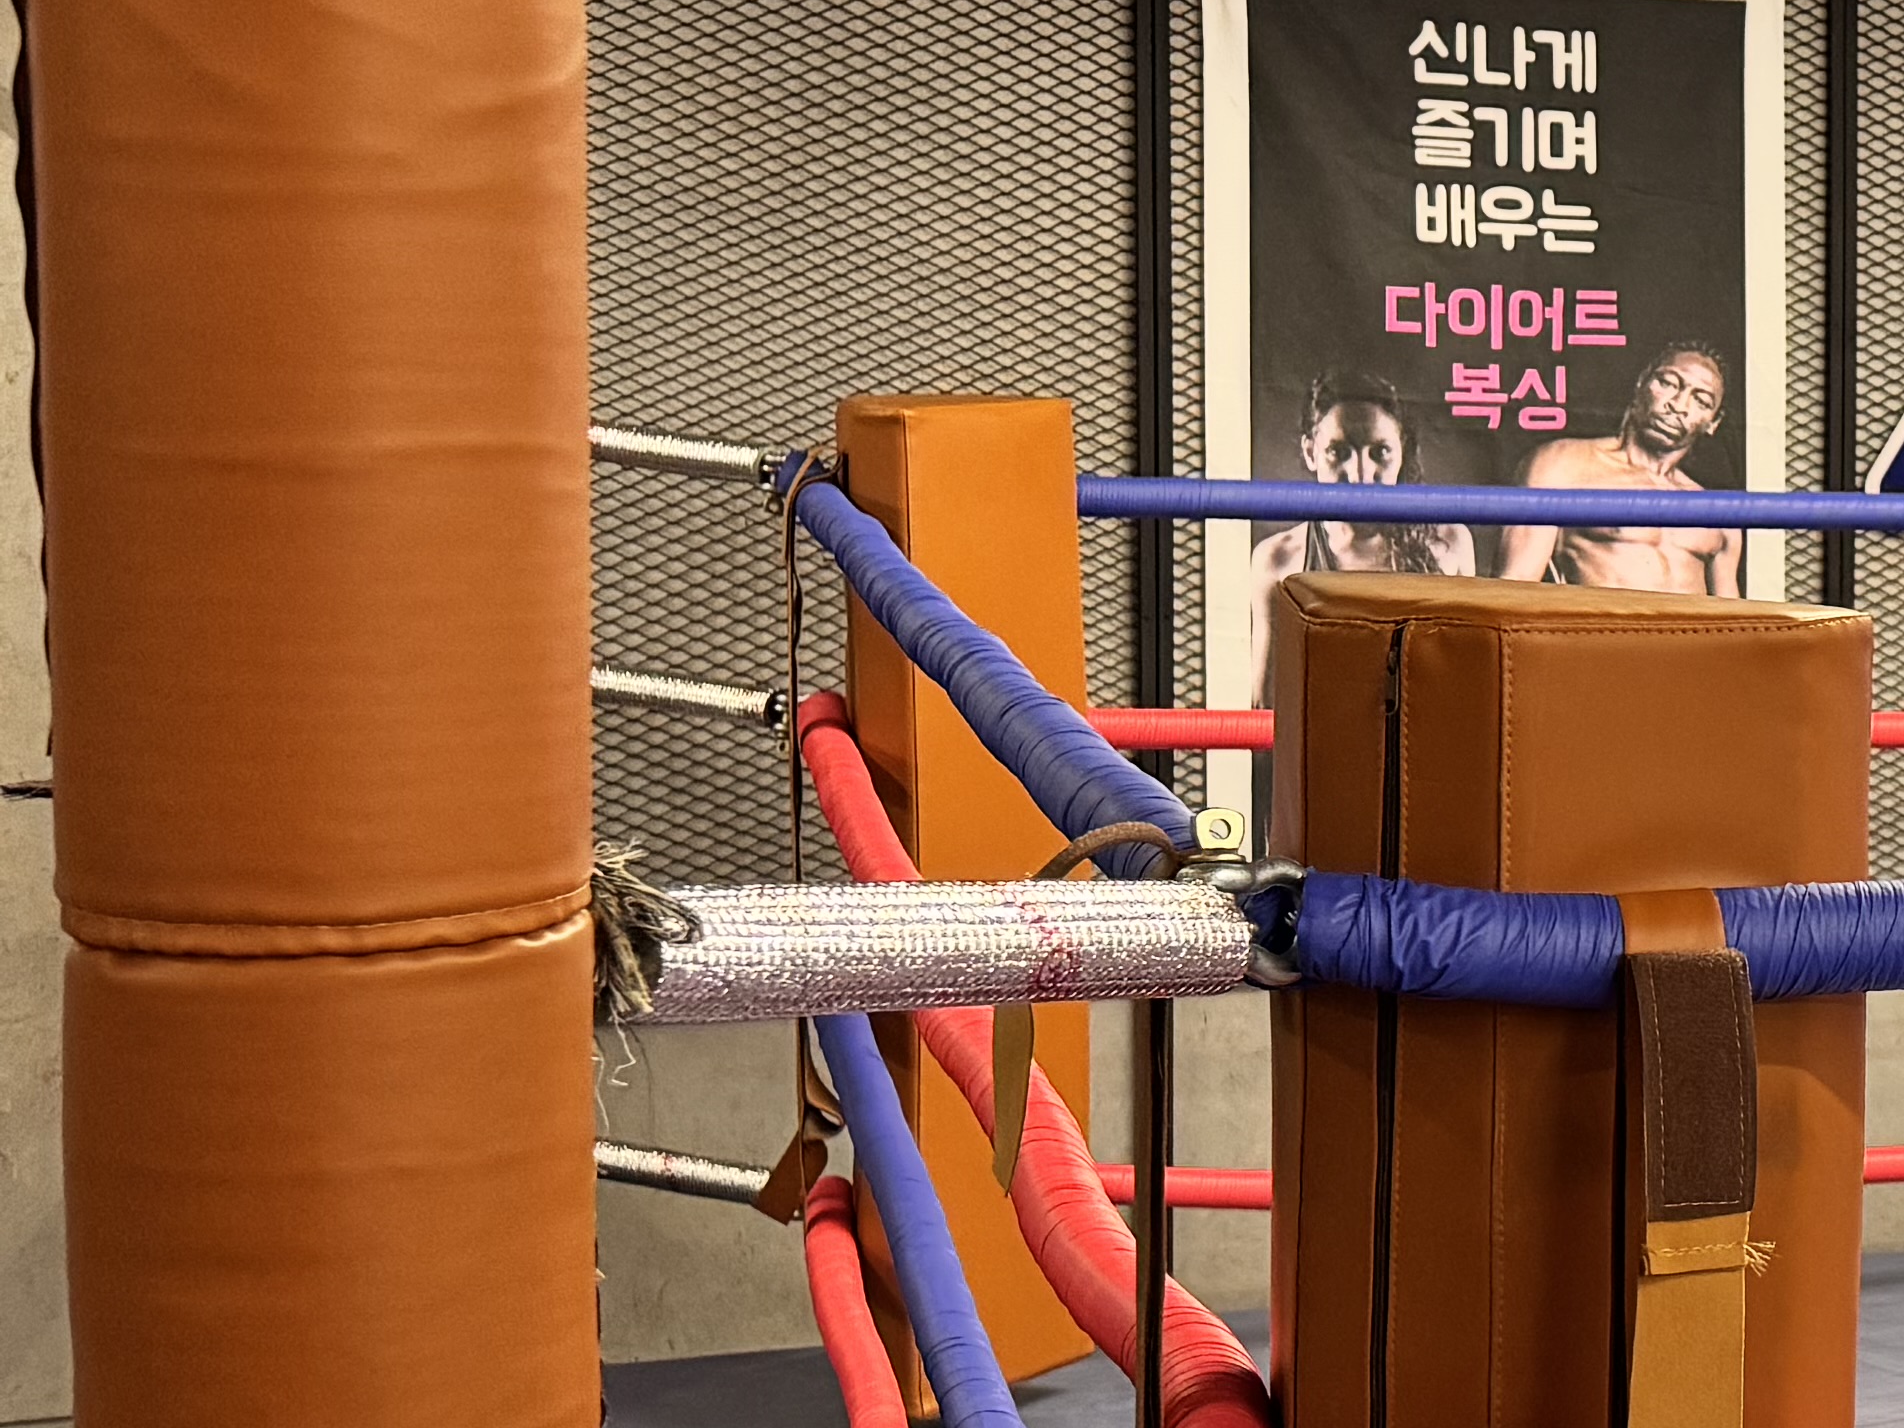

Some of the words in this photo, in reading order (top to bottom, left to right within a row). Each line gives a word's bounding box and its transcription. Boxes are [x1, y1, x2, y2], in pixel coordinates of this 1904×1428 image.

[1408, 19, 1598, 94] 신나게
[1411, 98, 1599, 175] 즐기며
[1414, 181, 1600, 254] 배우는
[1384, 281, 1628, 351] 다이어트
[1443, 361, 1569, 431] 복싱
